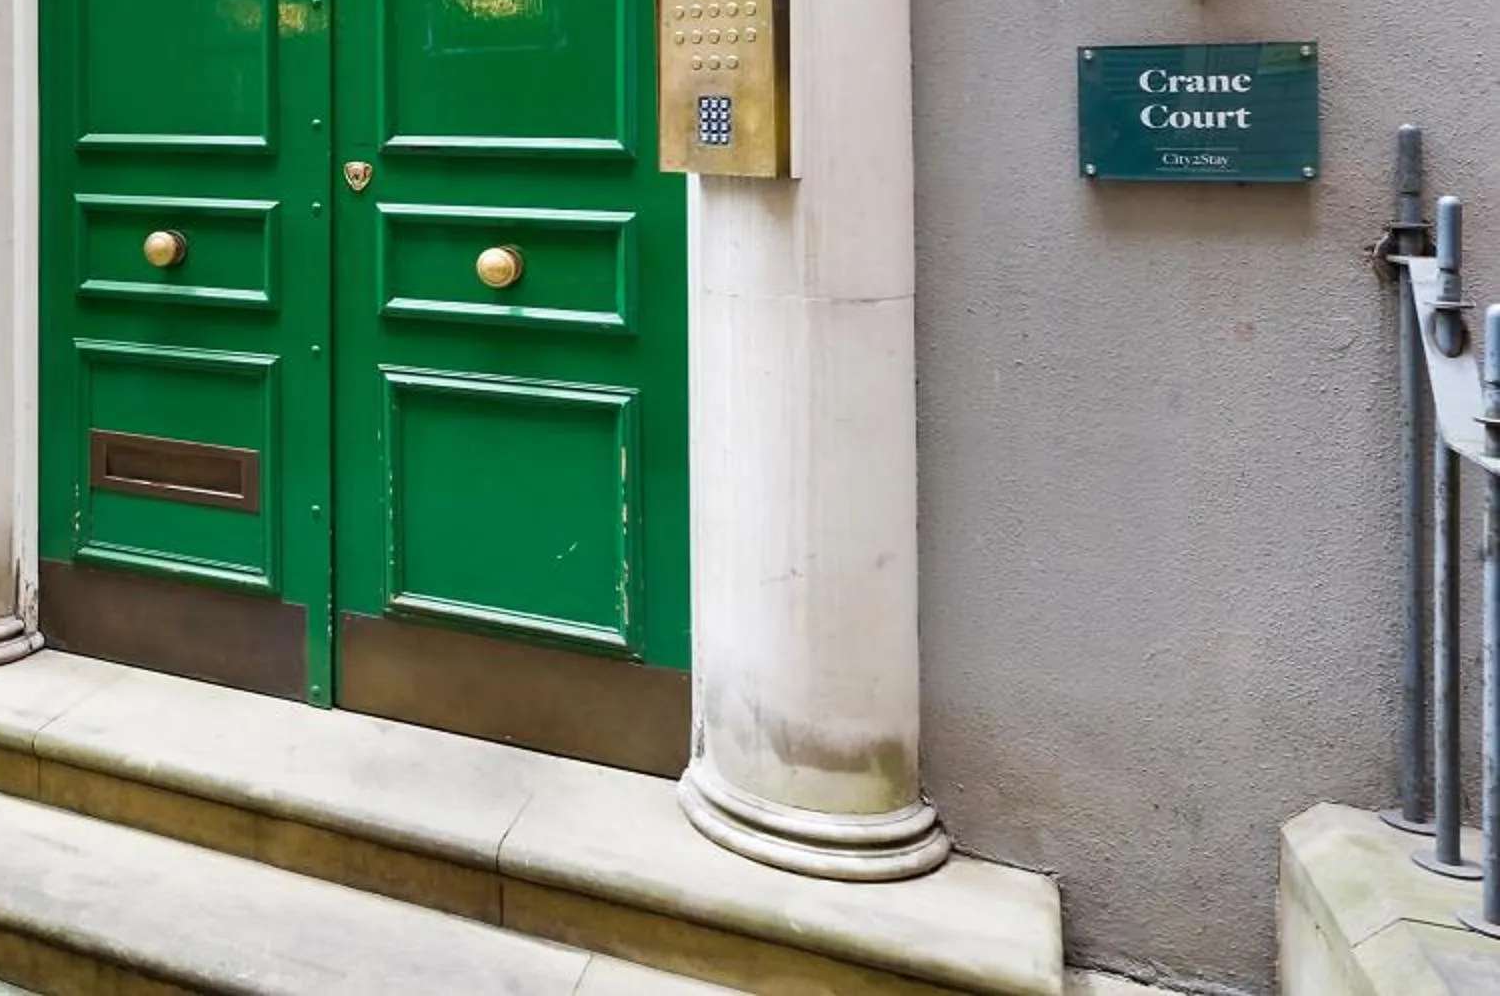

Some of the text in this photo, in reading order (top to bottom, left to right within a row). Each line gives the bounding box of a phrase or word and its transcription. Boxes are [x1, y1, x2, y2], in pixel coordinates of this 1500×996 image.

[1139, 69, 1252, 93] Crane
[1139, 104, 1252, 129] Court
[1162, 153, 1229, 168] City2Stay
